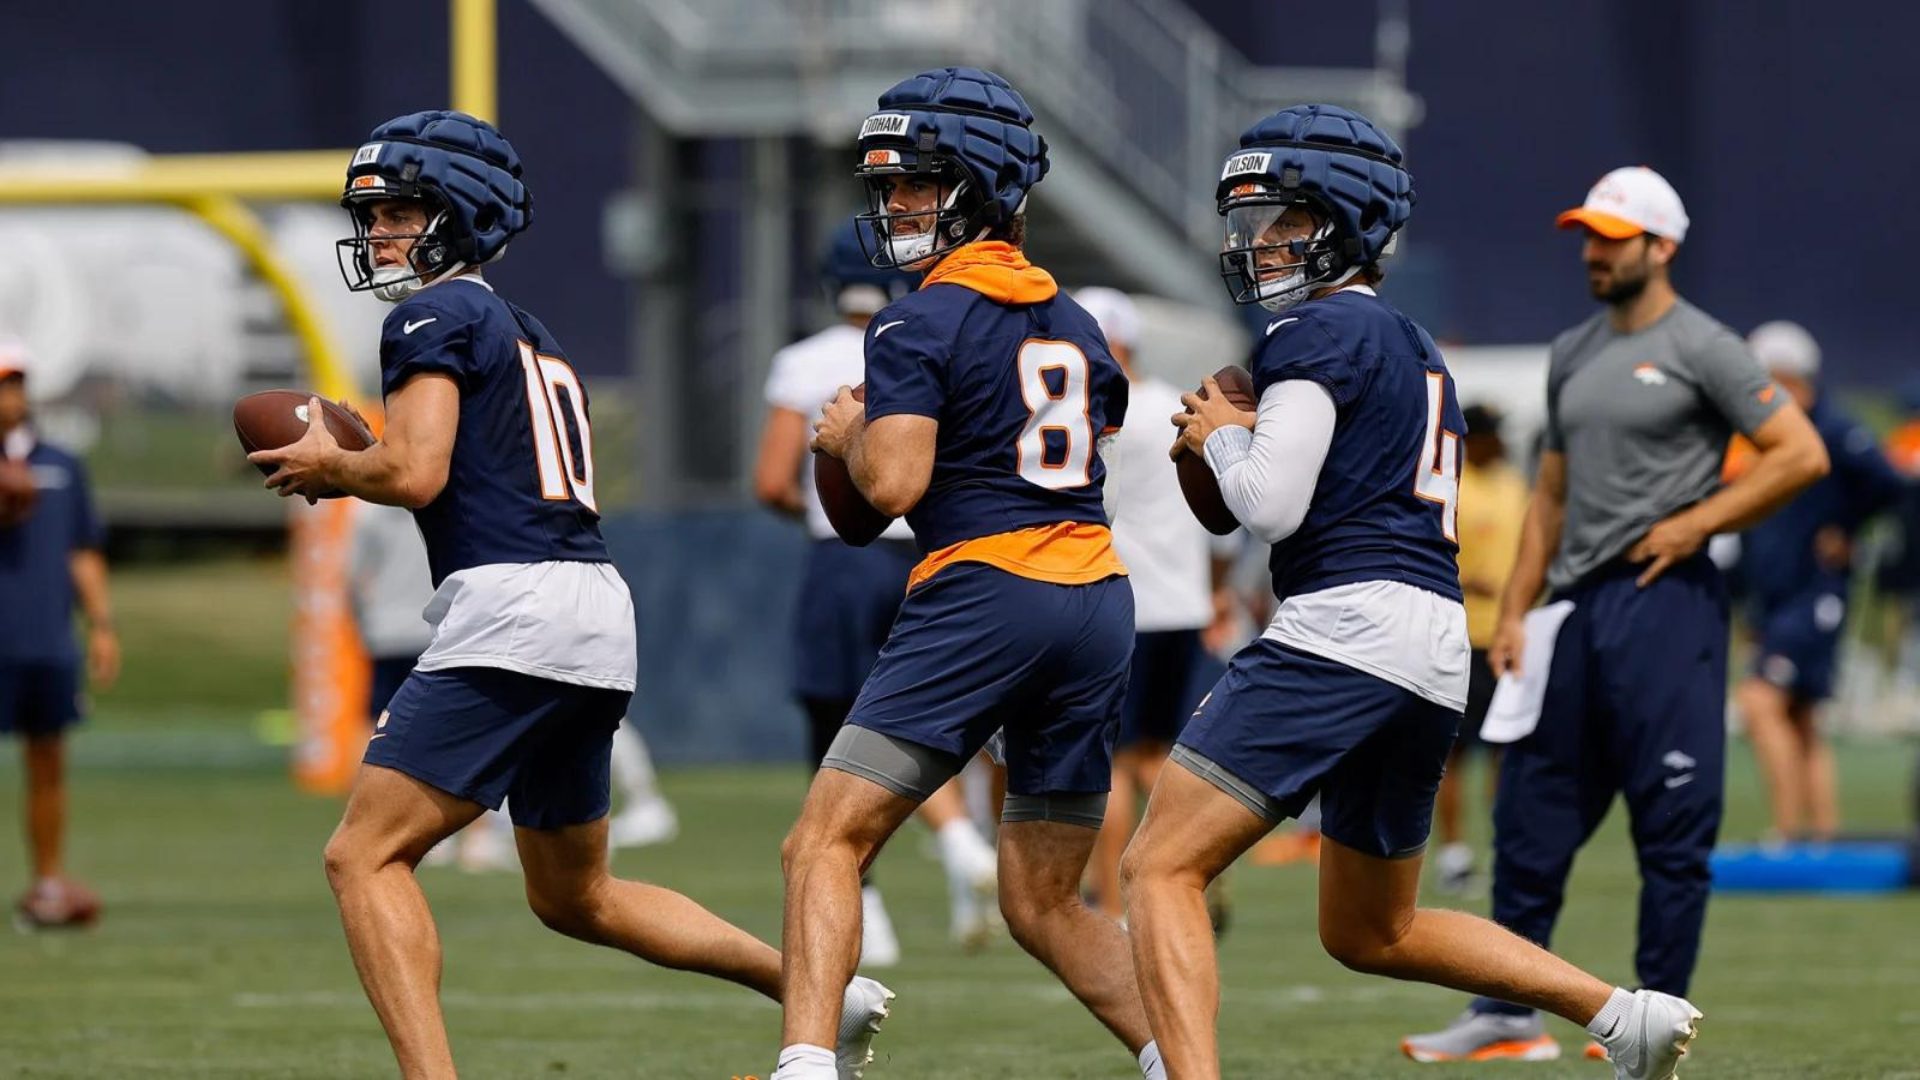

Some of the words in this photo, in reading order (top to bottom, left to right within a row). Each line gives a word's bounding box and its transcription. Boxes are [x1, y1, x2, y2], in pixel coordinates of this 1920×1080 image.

[356, 146, 376, 163] NIX
[517, 338, 599, 514] 10
[1016, 338, 1093, 491] 8
[1413, 369, 1459, 544] 4
